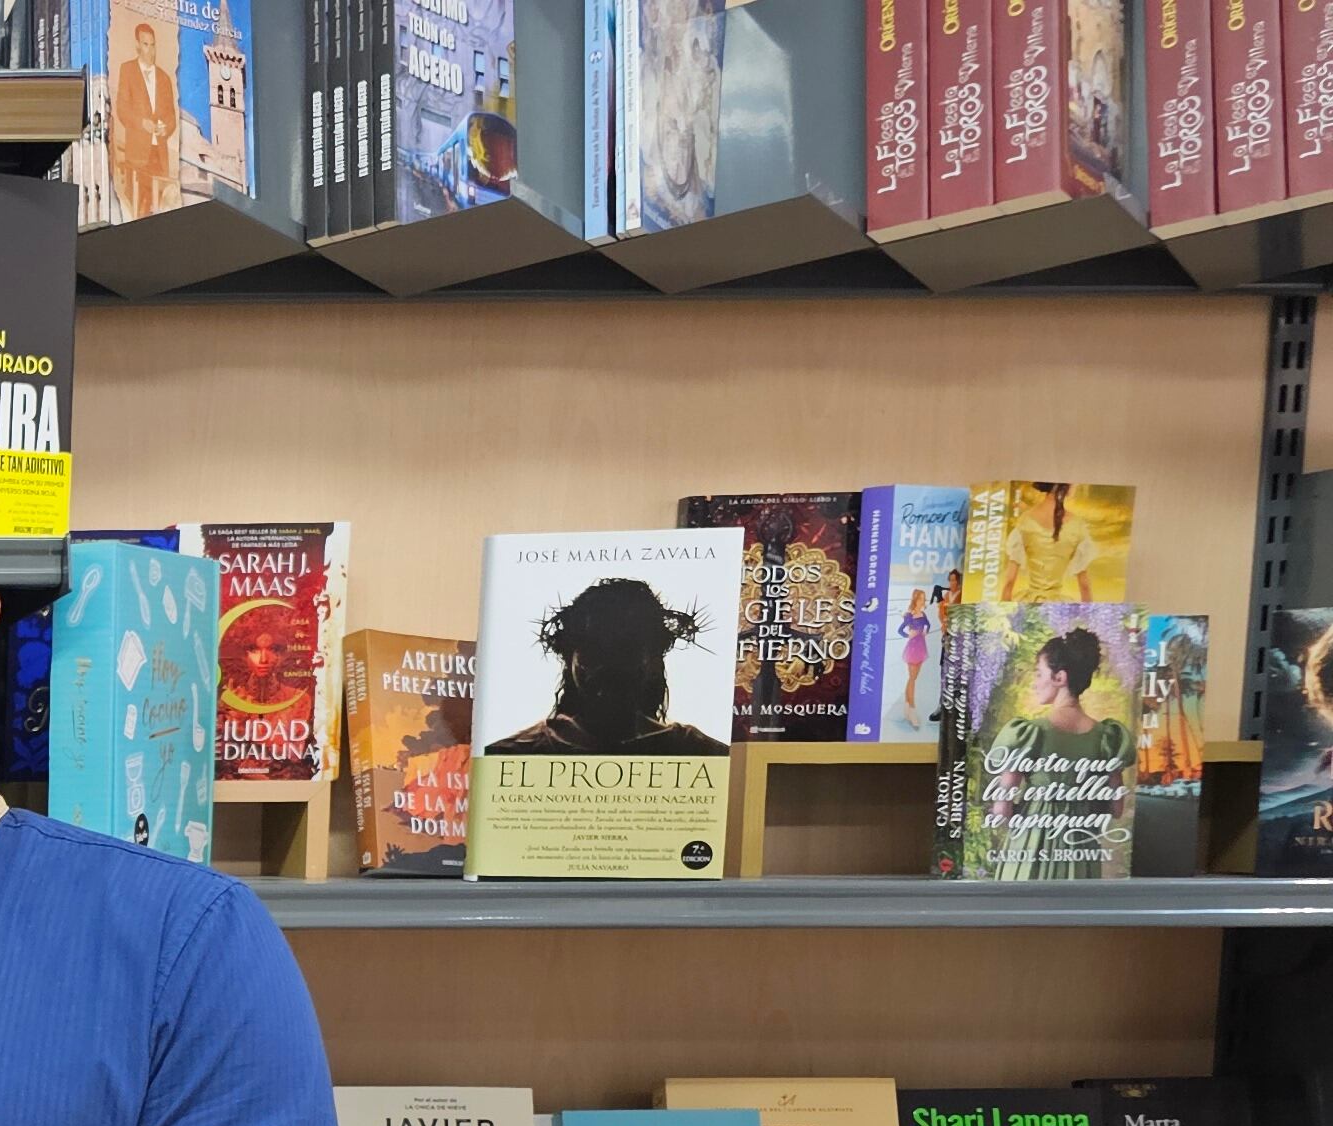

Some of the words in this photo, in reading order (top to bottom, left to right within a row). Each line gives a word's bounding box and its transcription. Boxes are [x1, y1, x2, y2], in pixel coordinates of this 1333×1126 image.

[408, 58, 464, 95] ACERO
[219, 552, 293, 574] SARAH
[297, 555, 311, 576] J.
[517, 549, 559, 564] JOSÉ
[567, 546, 632, 562] MARÍA
[641, 547, 716, 561] ZAVALA
[229, 576, 296, 597] MAAS
[498, 761, 535, 788] EL
[548, 761, 715, 789] PROFETA
[983, 746, 1069, 778] Hasta
[1074, 758, 1121, 780] que
[982, 781, 1025, 802] las
[1029, 781, 1131, 802] estrellas
[982, 812, 1008, 829] se
[1011, 813, 1112, 839] apaguen
[986, 848, 1035, 863] CAROL
[1038, 849, 1050, 862] S.
[1053, 848, 1113, 863] BROWN
